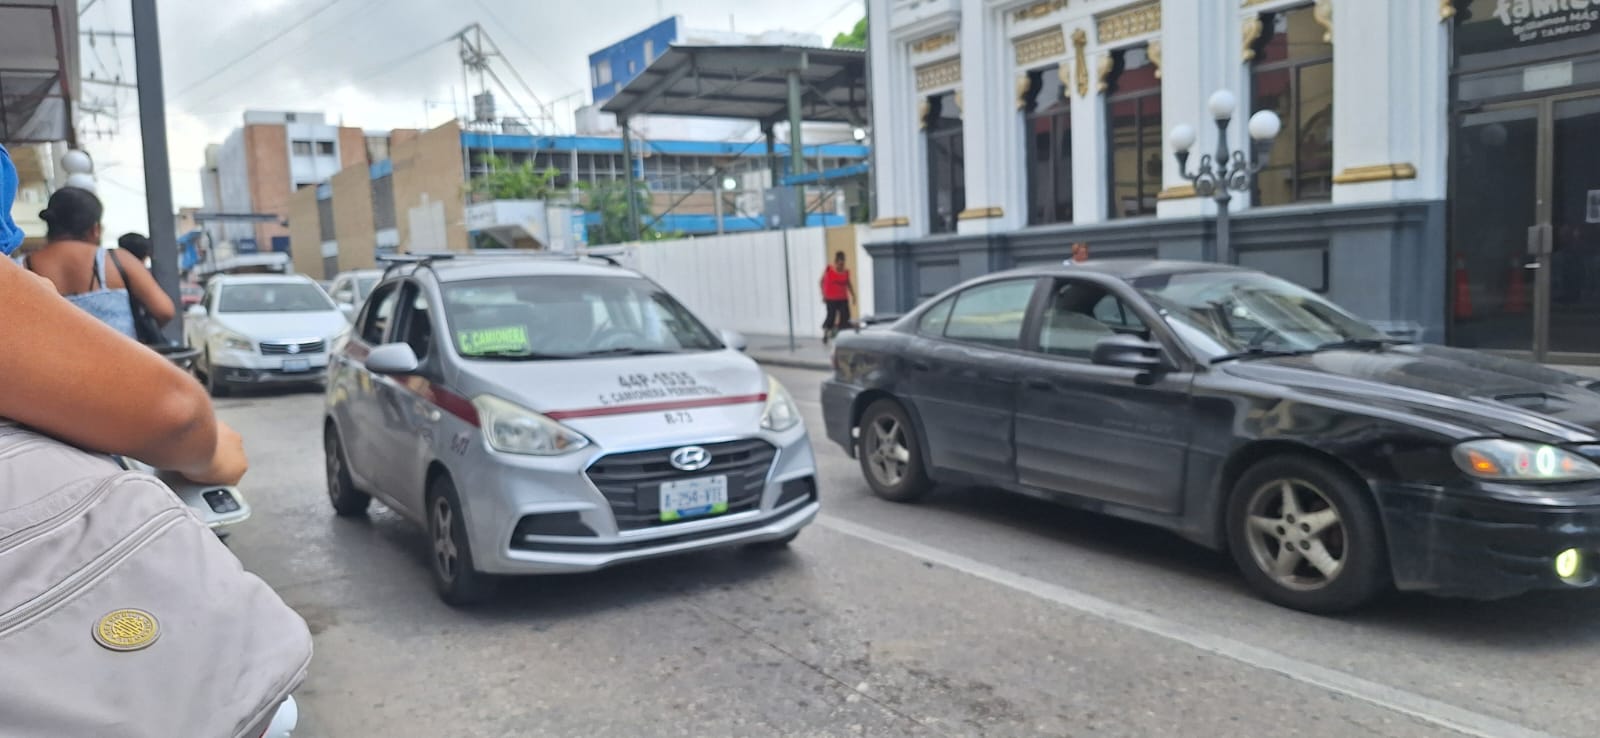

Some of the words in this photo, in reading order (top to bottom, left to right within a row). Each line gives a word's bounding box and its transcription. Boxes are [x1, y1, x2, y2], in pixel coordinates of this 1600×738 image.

[1541, 22, 1592, 38] TAMPICO
[472, 326, 527, 347] CAMIONERA
[618, 371, 697, 389] 44P-1535
[611, 388, 668, 402] CAMIONERA
[663, 411, 693, 424] R-73
